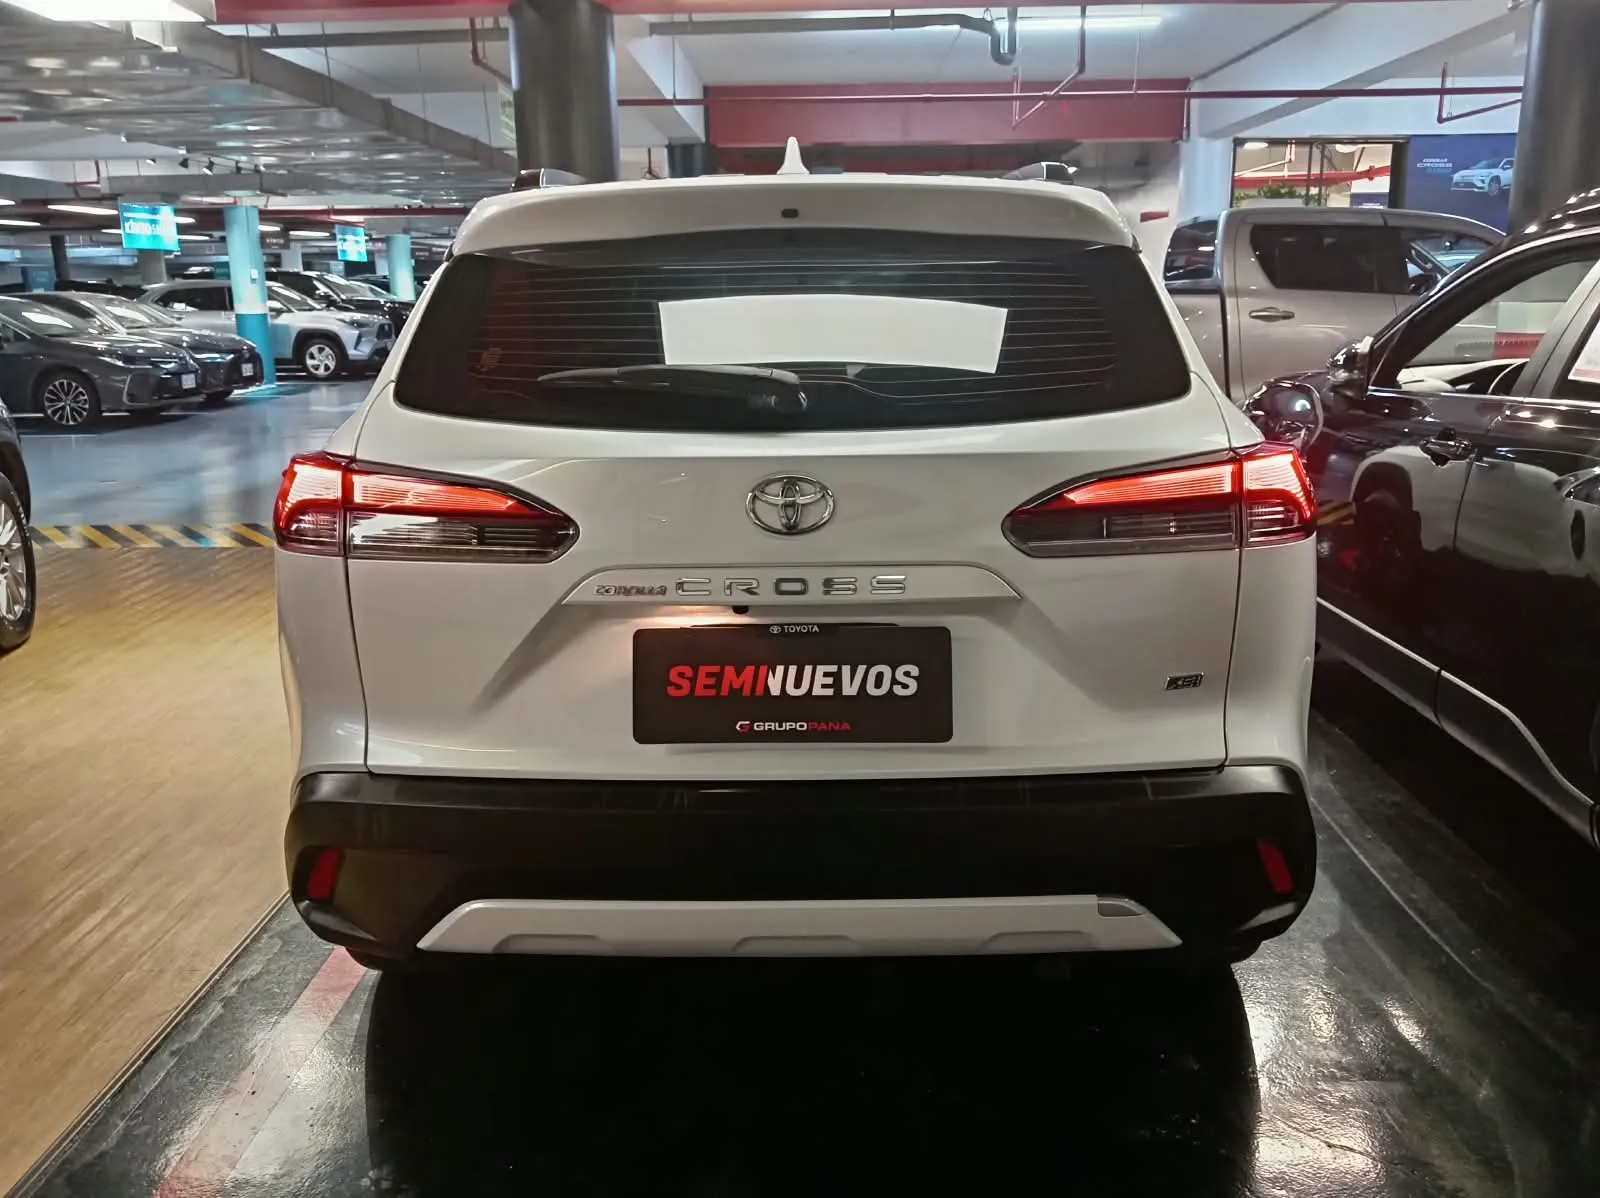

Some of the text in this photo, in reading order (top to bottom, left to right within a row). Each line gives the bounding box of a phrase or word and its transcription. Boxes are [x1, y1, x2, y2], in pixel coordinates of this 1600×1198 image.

[675, 576, 907, 596] CROSS
[783, 625, 820, 633] TOYOTA
[666, 664, 920, 697] SEMINUEVOS
